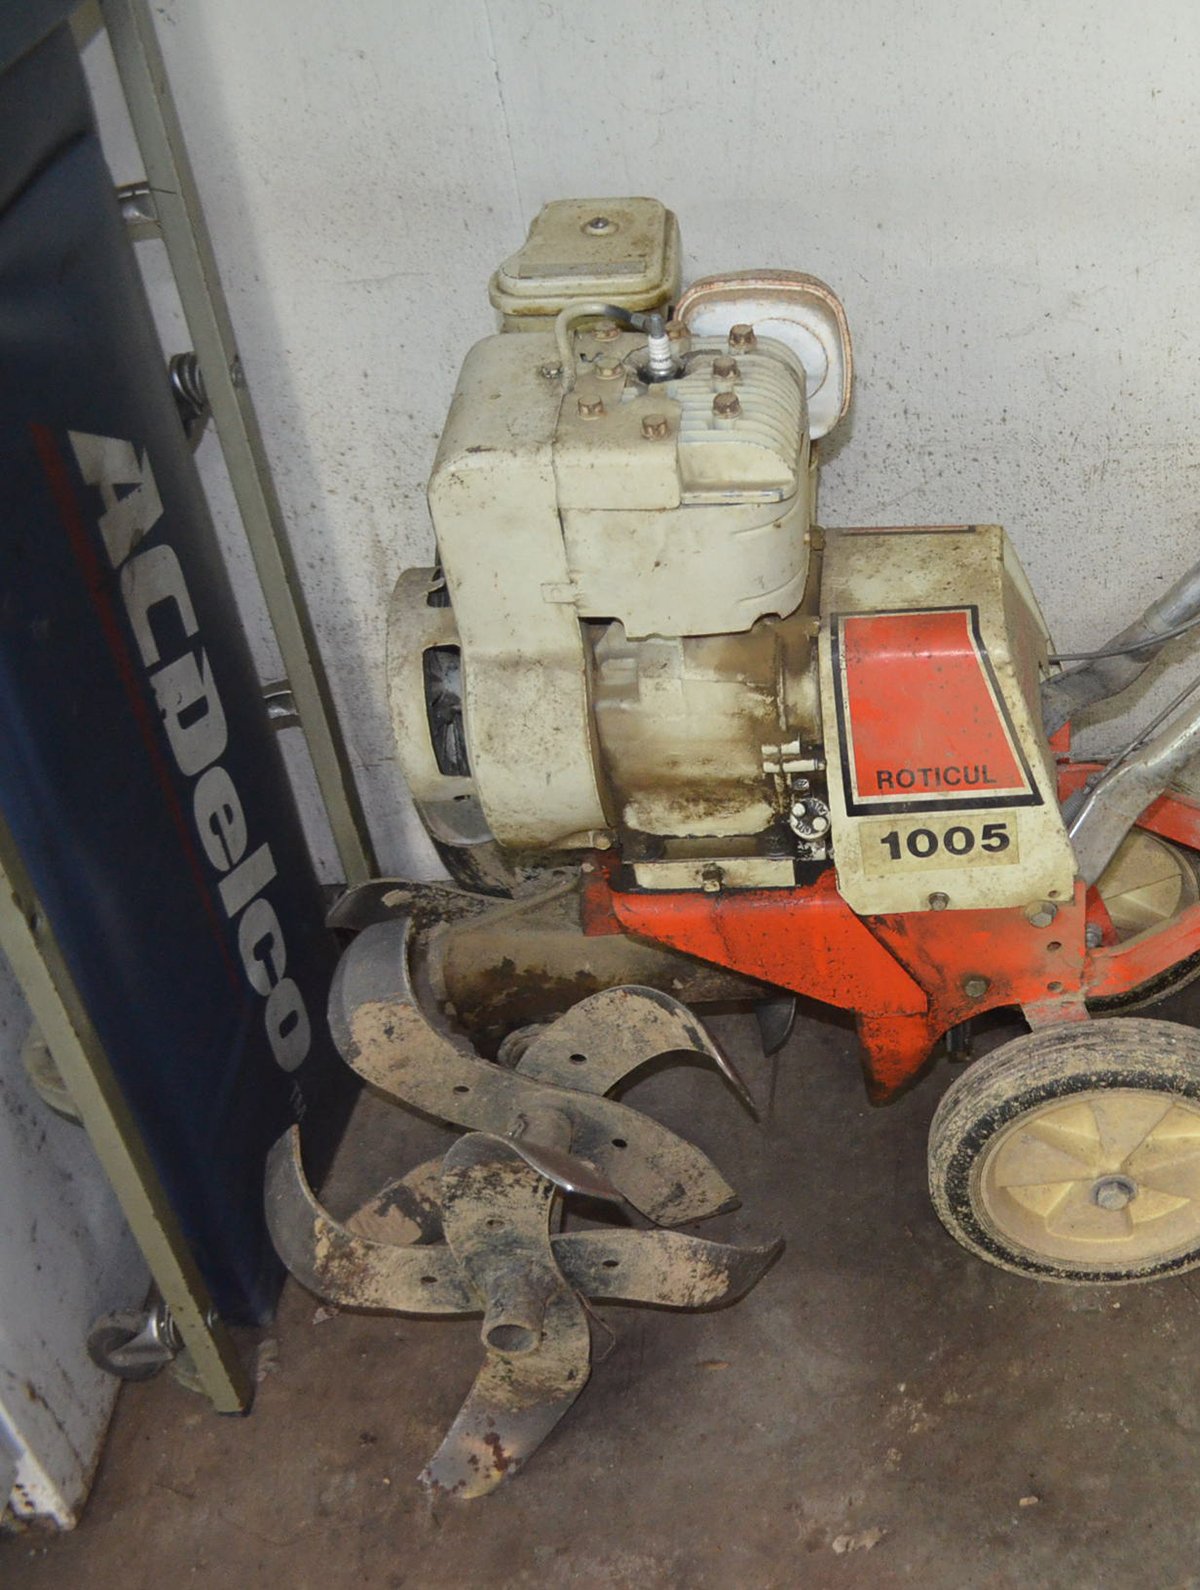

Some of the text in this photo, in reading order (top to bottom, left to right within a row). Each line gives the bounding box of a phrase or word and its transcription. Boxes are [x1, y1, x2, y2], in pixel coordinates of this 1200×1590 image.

[67, 430, 311, 1071] ACDelco
[876, 764, 996, 790] ROTICUL
[881, 823, 1010, 860] 1005
